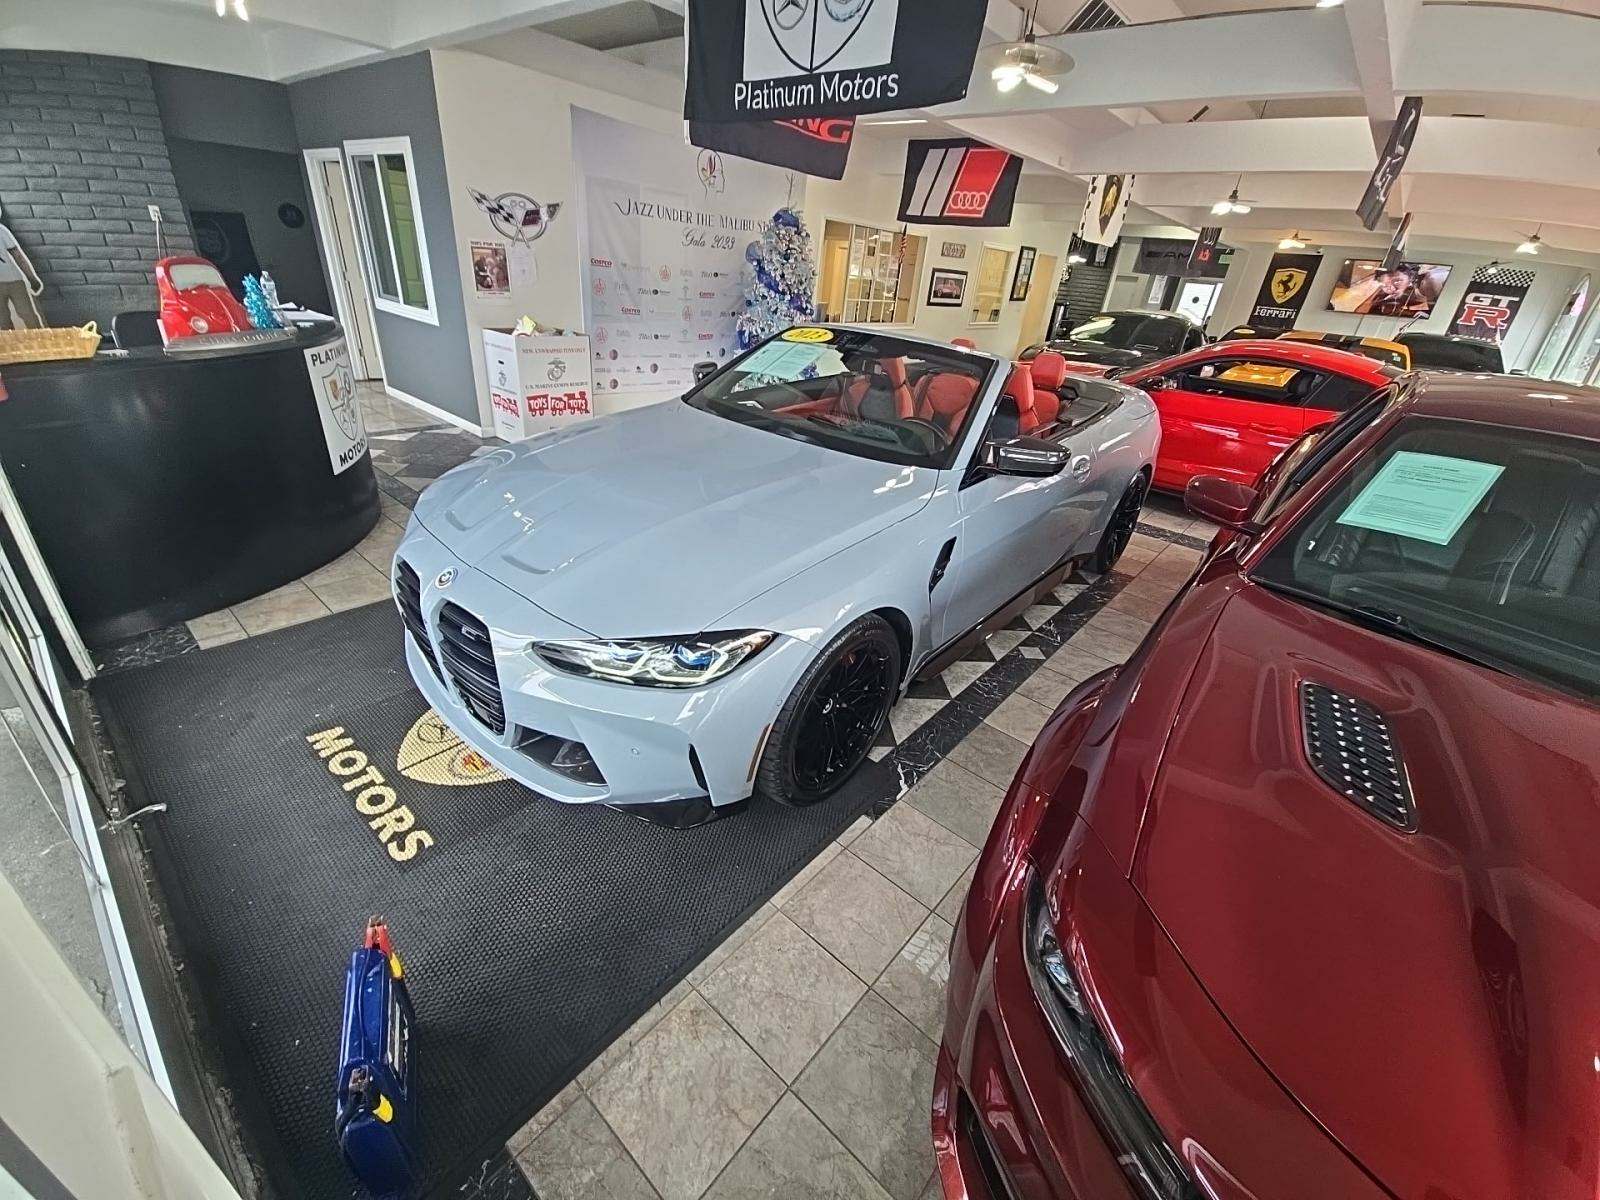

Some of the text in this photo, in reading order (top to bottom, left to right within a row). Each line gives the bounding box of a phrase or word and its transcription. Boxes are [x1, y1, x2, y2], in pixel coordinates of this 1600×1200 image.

[734, 73, 900, 111] Platinum Motors
[614, 198, 654, 218] JAZZ
[656, 205, 693, 224] UNDER
[695, 212, 715, 228] THE
[719, 214, 757, 232] MALIBU
[681, 227, 736, 250] Gala 2023
[1253, 305, 1298, 319] Ferrari
[1464, 293, 1520, 308] GT
[1456, 304, 1511, 329] R
[529, 397, 548, 409] TOYS
[551, 399, 566, 410] FOR
[568, 397, 586, 408] TOTS
[306, 726, 434, 862] MOTORS
